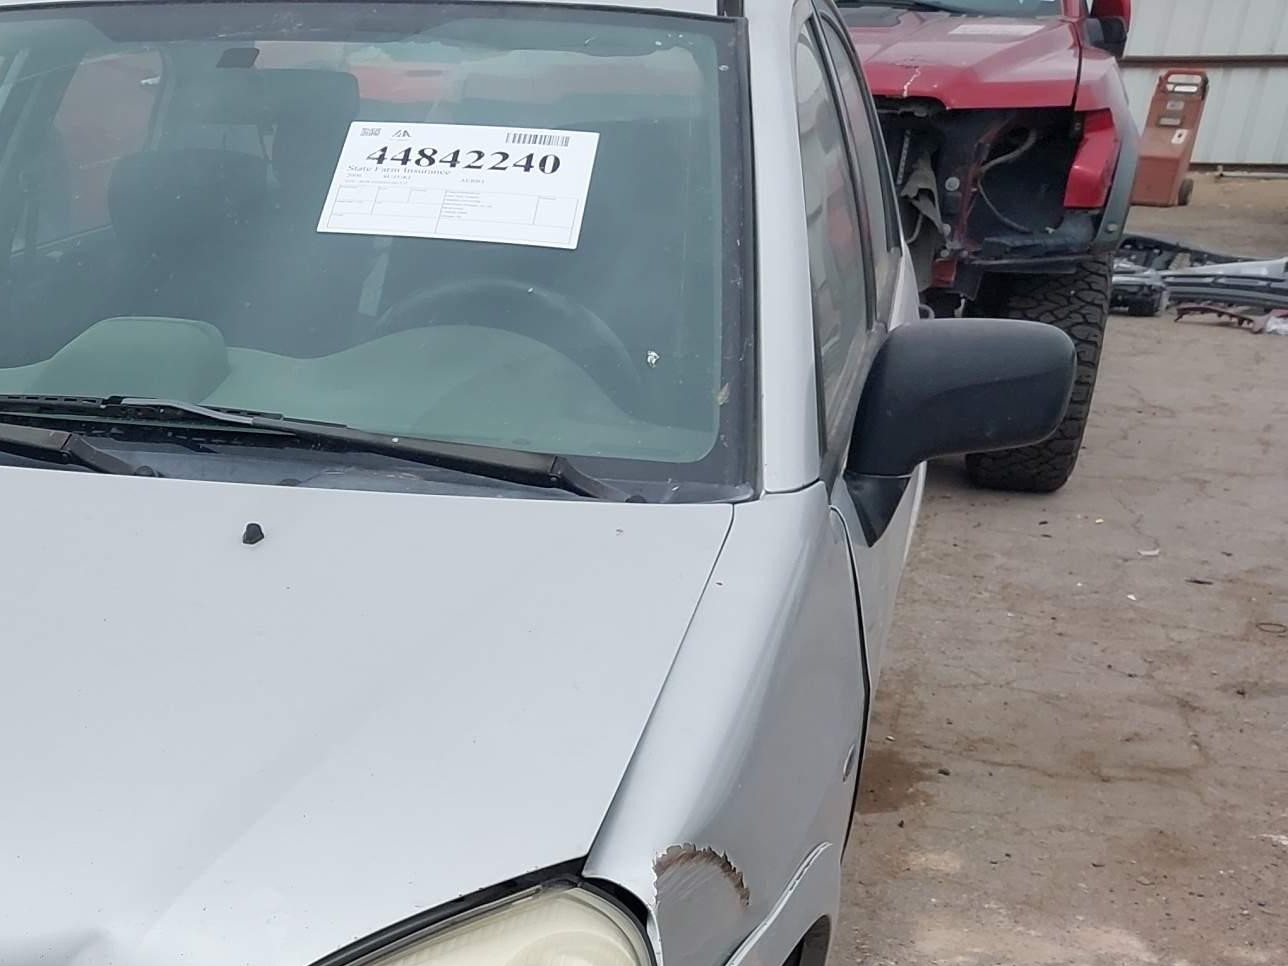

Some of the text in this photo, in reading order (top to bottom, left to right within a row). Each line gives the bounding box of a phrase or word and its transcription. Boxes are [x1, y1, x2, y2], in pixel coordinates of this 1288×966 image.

[366, 146, 561, 175] 44842240
[373, 166, 401, 174] Farm
[402, 167, 452, 176] Insurance
